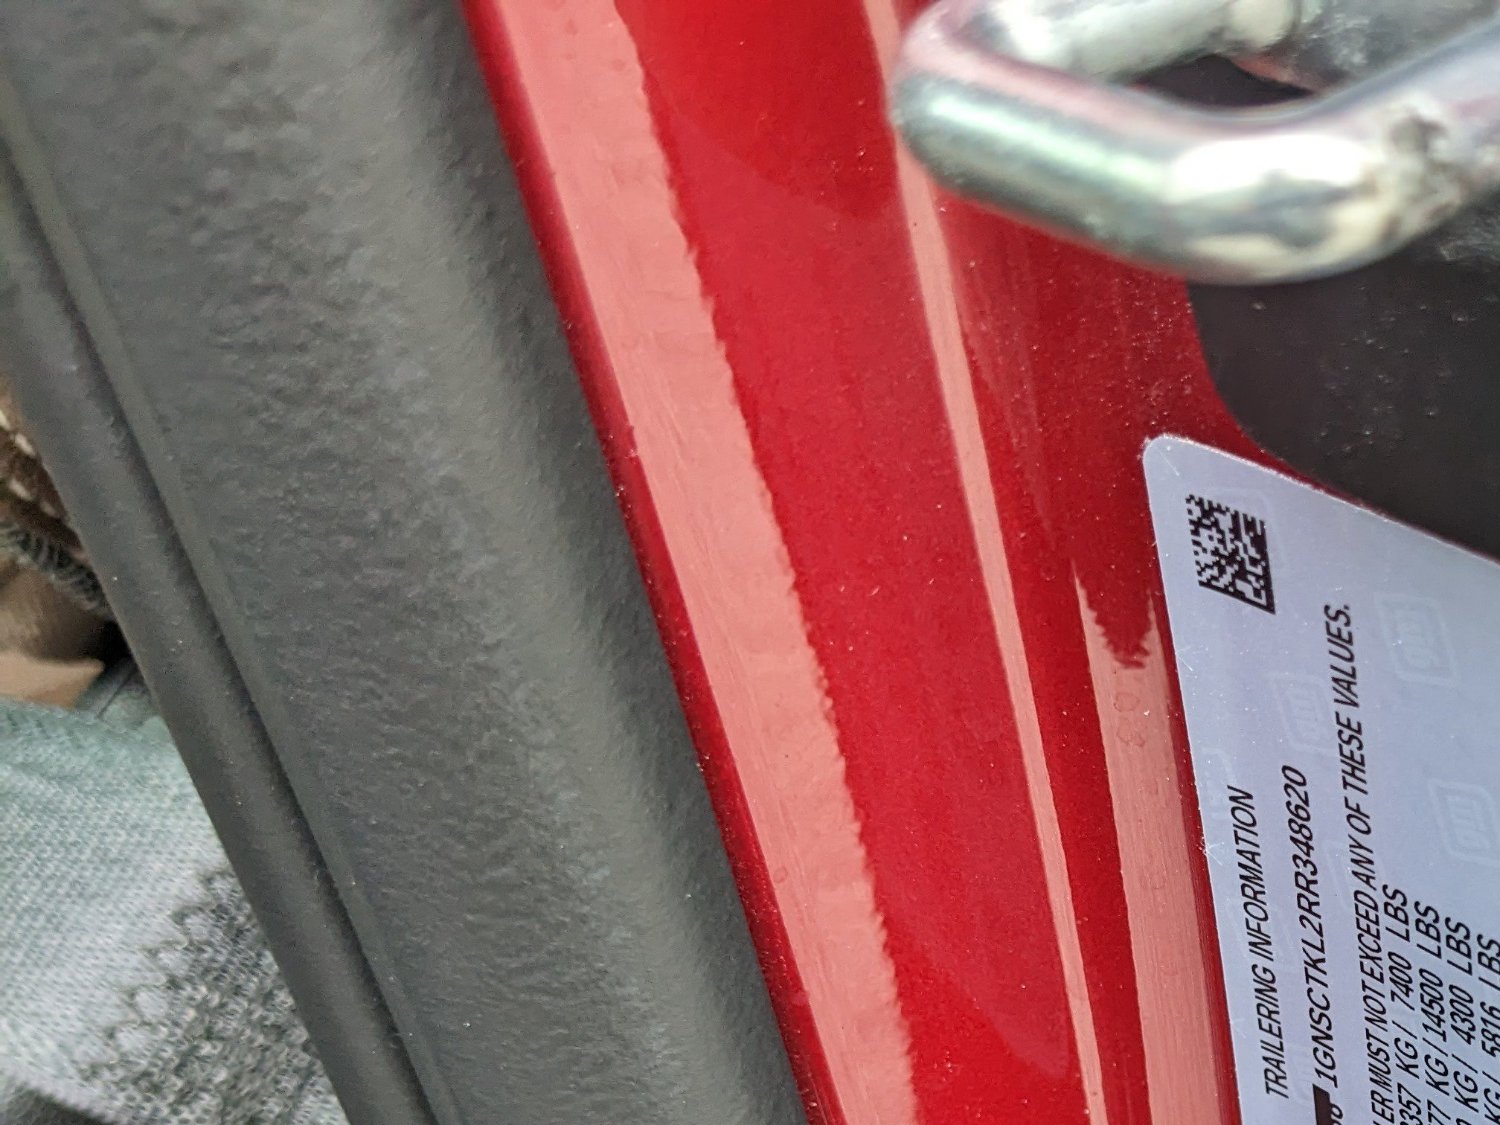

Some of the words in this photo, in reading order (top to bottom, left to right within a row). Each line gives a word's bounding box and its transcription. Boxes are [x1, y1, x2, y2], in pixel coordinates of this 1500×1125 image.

[1323, 604, 1359, 709] VALUES.
[1334, 711, 1368, 795] THESE
[1343, 797, 1372, 836] OF
[1227, 785, 1274, 961] INFORMATION
[1348, 834, 1378, 890] ANY
[1281, 765, 1338, 1088] 1GNSCTKL2RR348620
[1353, 891, 1384, 984] EXCEED
[1382, 884, 1411, 943] LBS
[1414, 901, 1443, 959] LBS
[1445, 917, 1473, 976] LBS
[1360, 979, 1389, 1031] NOT
[1388, 951, 1415, 1011] 7400
[1251, 965, 1289, 1099] TRAILERING
[1449, 984, 1476, 1045] 4300
[1364, 1028, 1393, 1089] MUST
